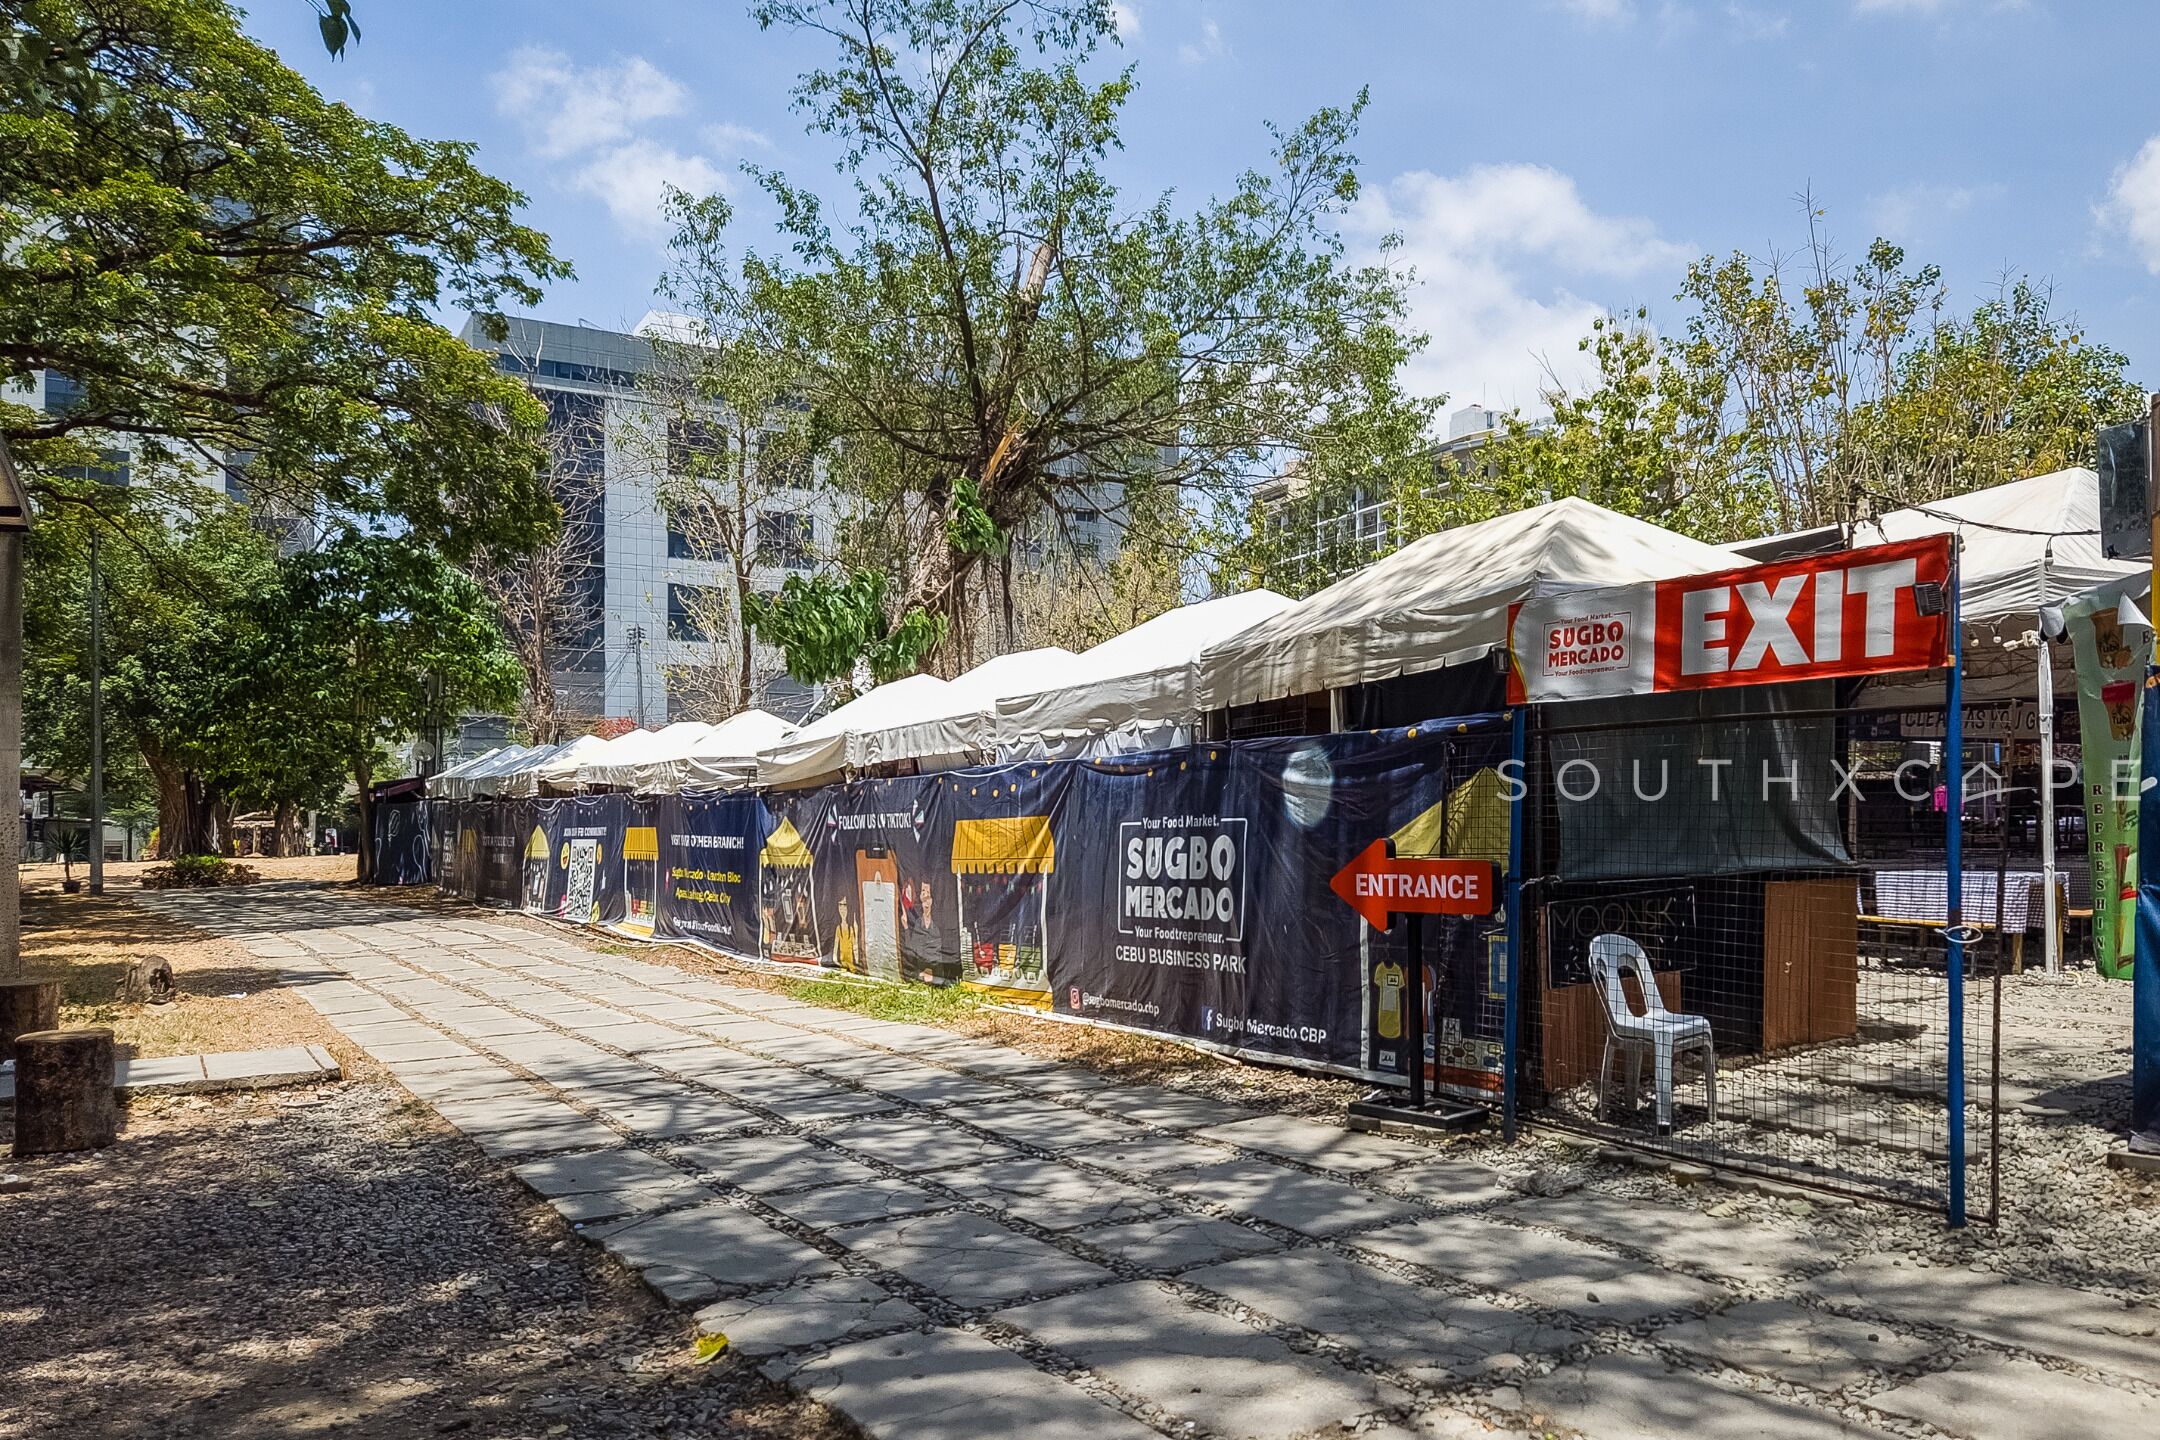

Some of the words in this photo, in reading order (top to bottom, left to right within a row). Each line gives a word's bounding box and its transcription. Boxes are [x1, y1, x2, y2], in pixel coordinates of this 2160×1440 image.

[1682, 558, 1917, 676] EXIT
[1549, 621, 1624, 649] SUGBO
[1548, 645, 1624, 668] MERCADO
[1905, 711, 1946, 728] CLEA
[1964, 708, 1986, 729] AS
[2026, 711, 2041, 730] G
[838, 813, 865, 830] FOLLOW
[866, 813, 876, 829] US
[1142, 817, 1161, 829] Your
[1162, 815, 1184, 828] Food
[1185, 814, 1220, 828] Market.
[713, 836, 745, 850] BRANCH!
[1126, 834, 1236, 881] SUGBO
[1355, 873, 1479, 900] ENTRANCE
[1125, 886, 1234, 922] MERCADO
[1134, 925, 1153, 938] Your
[1154, 927, 1225, 944] Foodtrepreneur.
[1115, 945, 1146, 963] CEBU
[1148, 948, 1210, 969] BUSINESS
[1212, 953, 1247, 974] PARK
[1082, 992, 1160, 1017] @sugbomercado.cbp
[1216, 1012, 1244, 1032] Sugbo
[1246, 1018, 1297, 1039] Mercado
[1300, 1026, 1327, 1044] CBP
